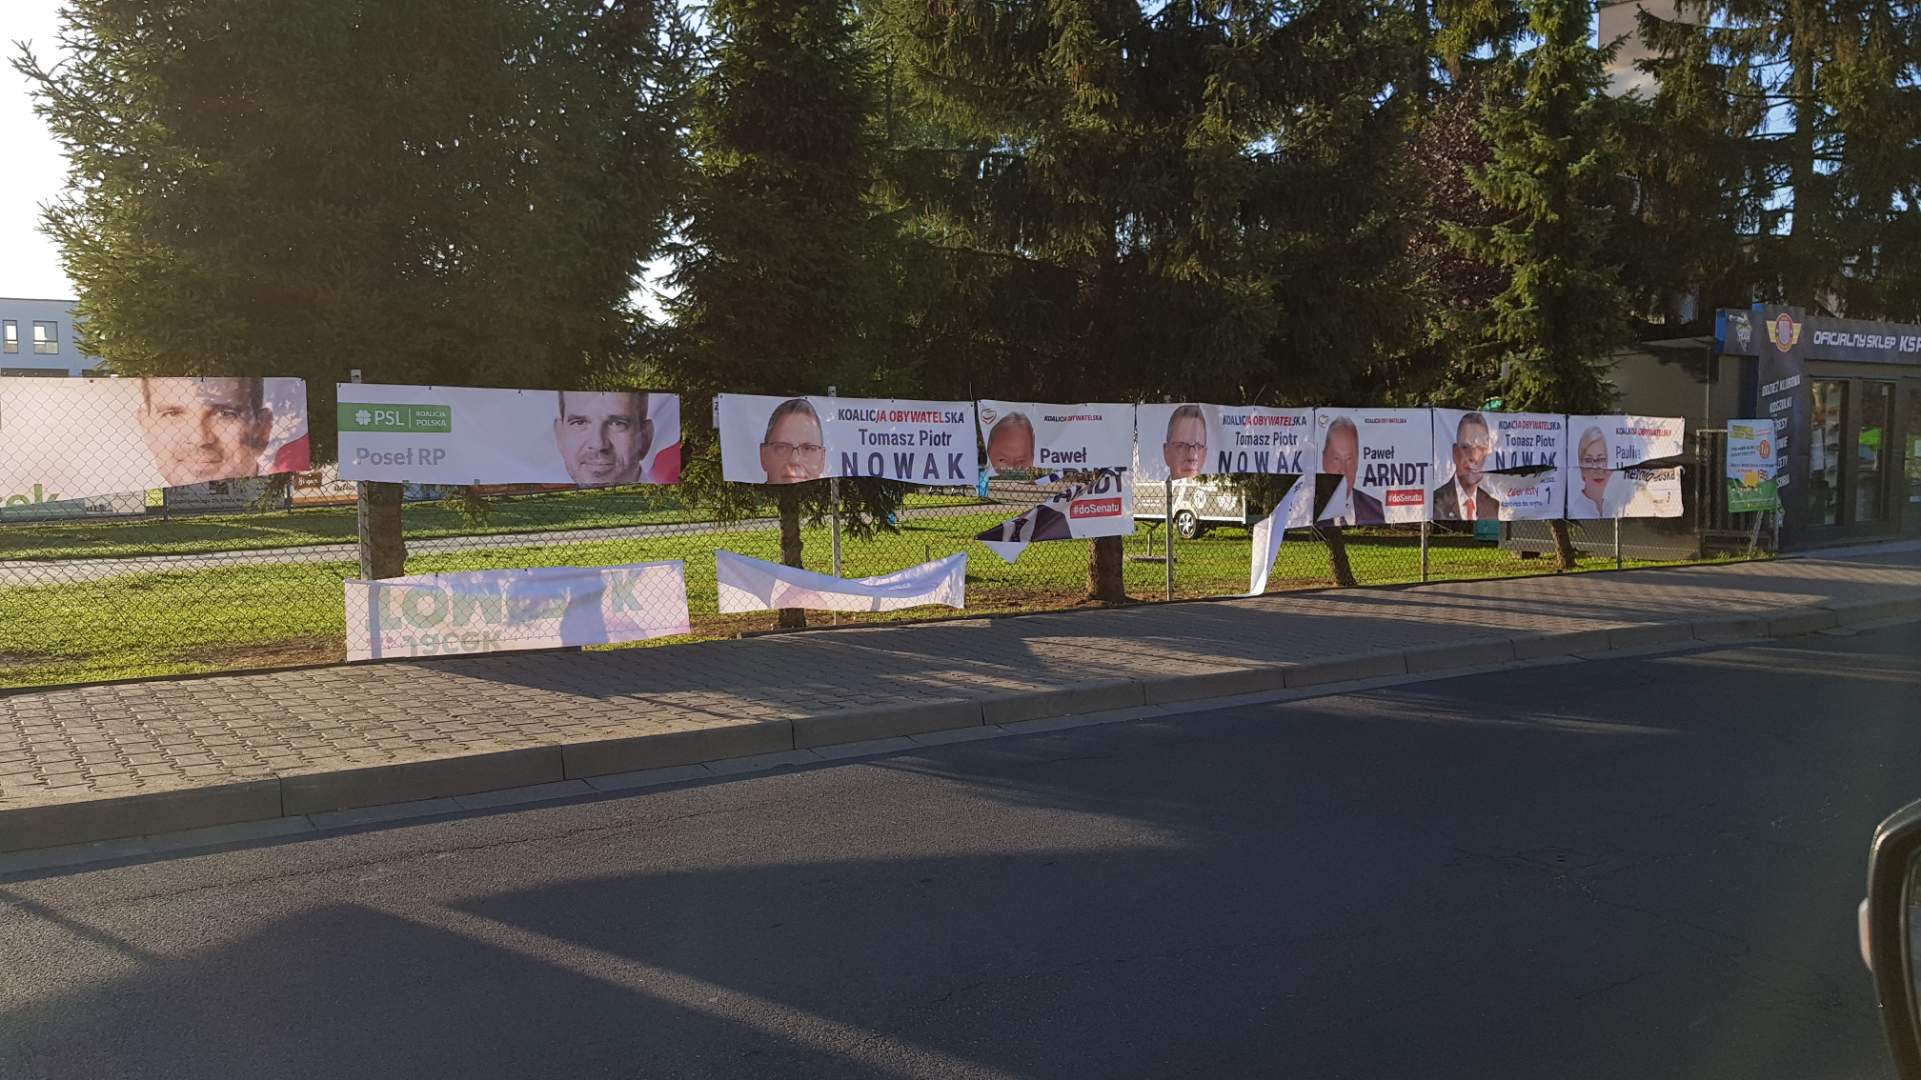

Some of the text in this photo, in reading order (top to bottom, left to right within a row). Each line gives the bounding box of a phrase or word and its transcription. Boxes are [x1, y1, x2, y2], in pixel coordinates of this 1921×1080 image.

[1813, 330, 1866, 348] OFICJALNY
[1867, 334, 1897, 350] SKLEP
[374, 410, 405, 426] PSL
[416, 419, 446, 427] POLSKA
[838, 407, 965, 424] KOALICJA OBYWATELSKA
[1253, 415, 1307, 426] OBYWATELSKA
[858, 428, 952, 446] Tomasz Piotr
[1235, 431, 1298, 446] Tomasz Piotr
[1536, 434, 1556, 448] Piotr
[356, 447, 446, 466] Poseł RP
[1040, 446, 1087, 464] Paweł
[1363, 445, 1394, 460] Paweł
[841, 451, 965, 480] NOWAK
[1217, 450, 1303, 474] NOWAK
[1362, 462, 1428, 488] ARNDT
[1073, 503, 1120, 514] #doSenatu
